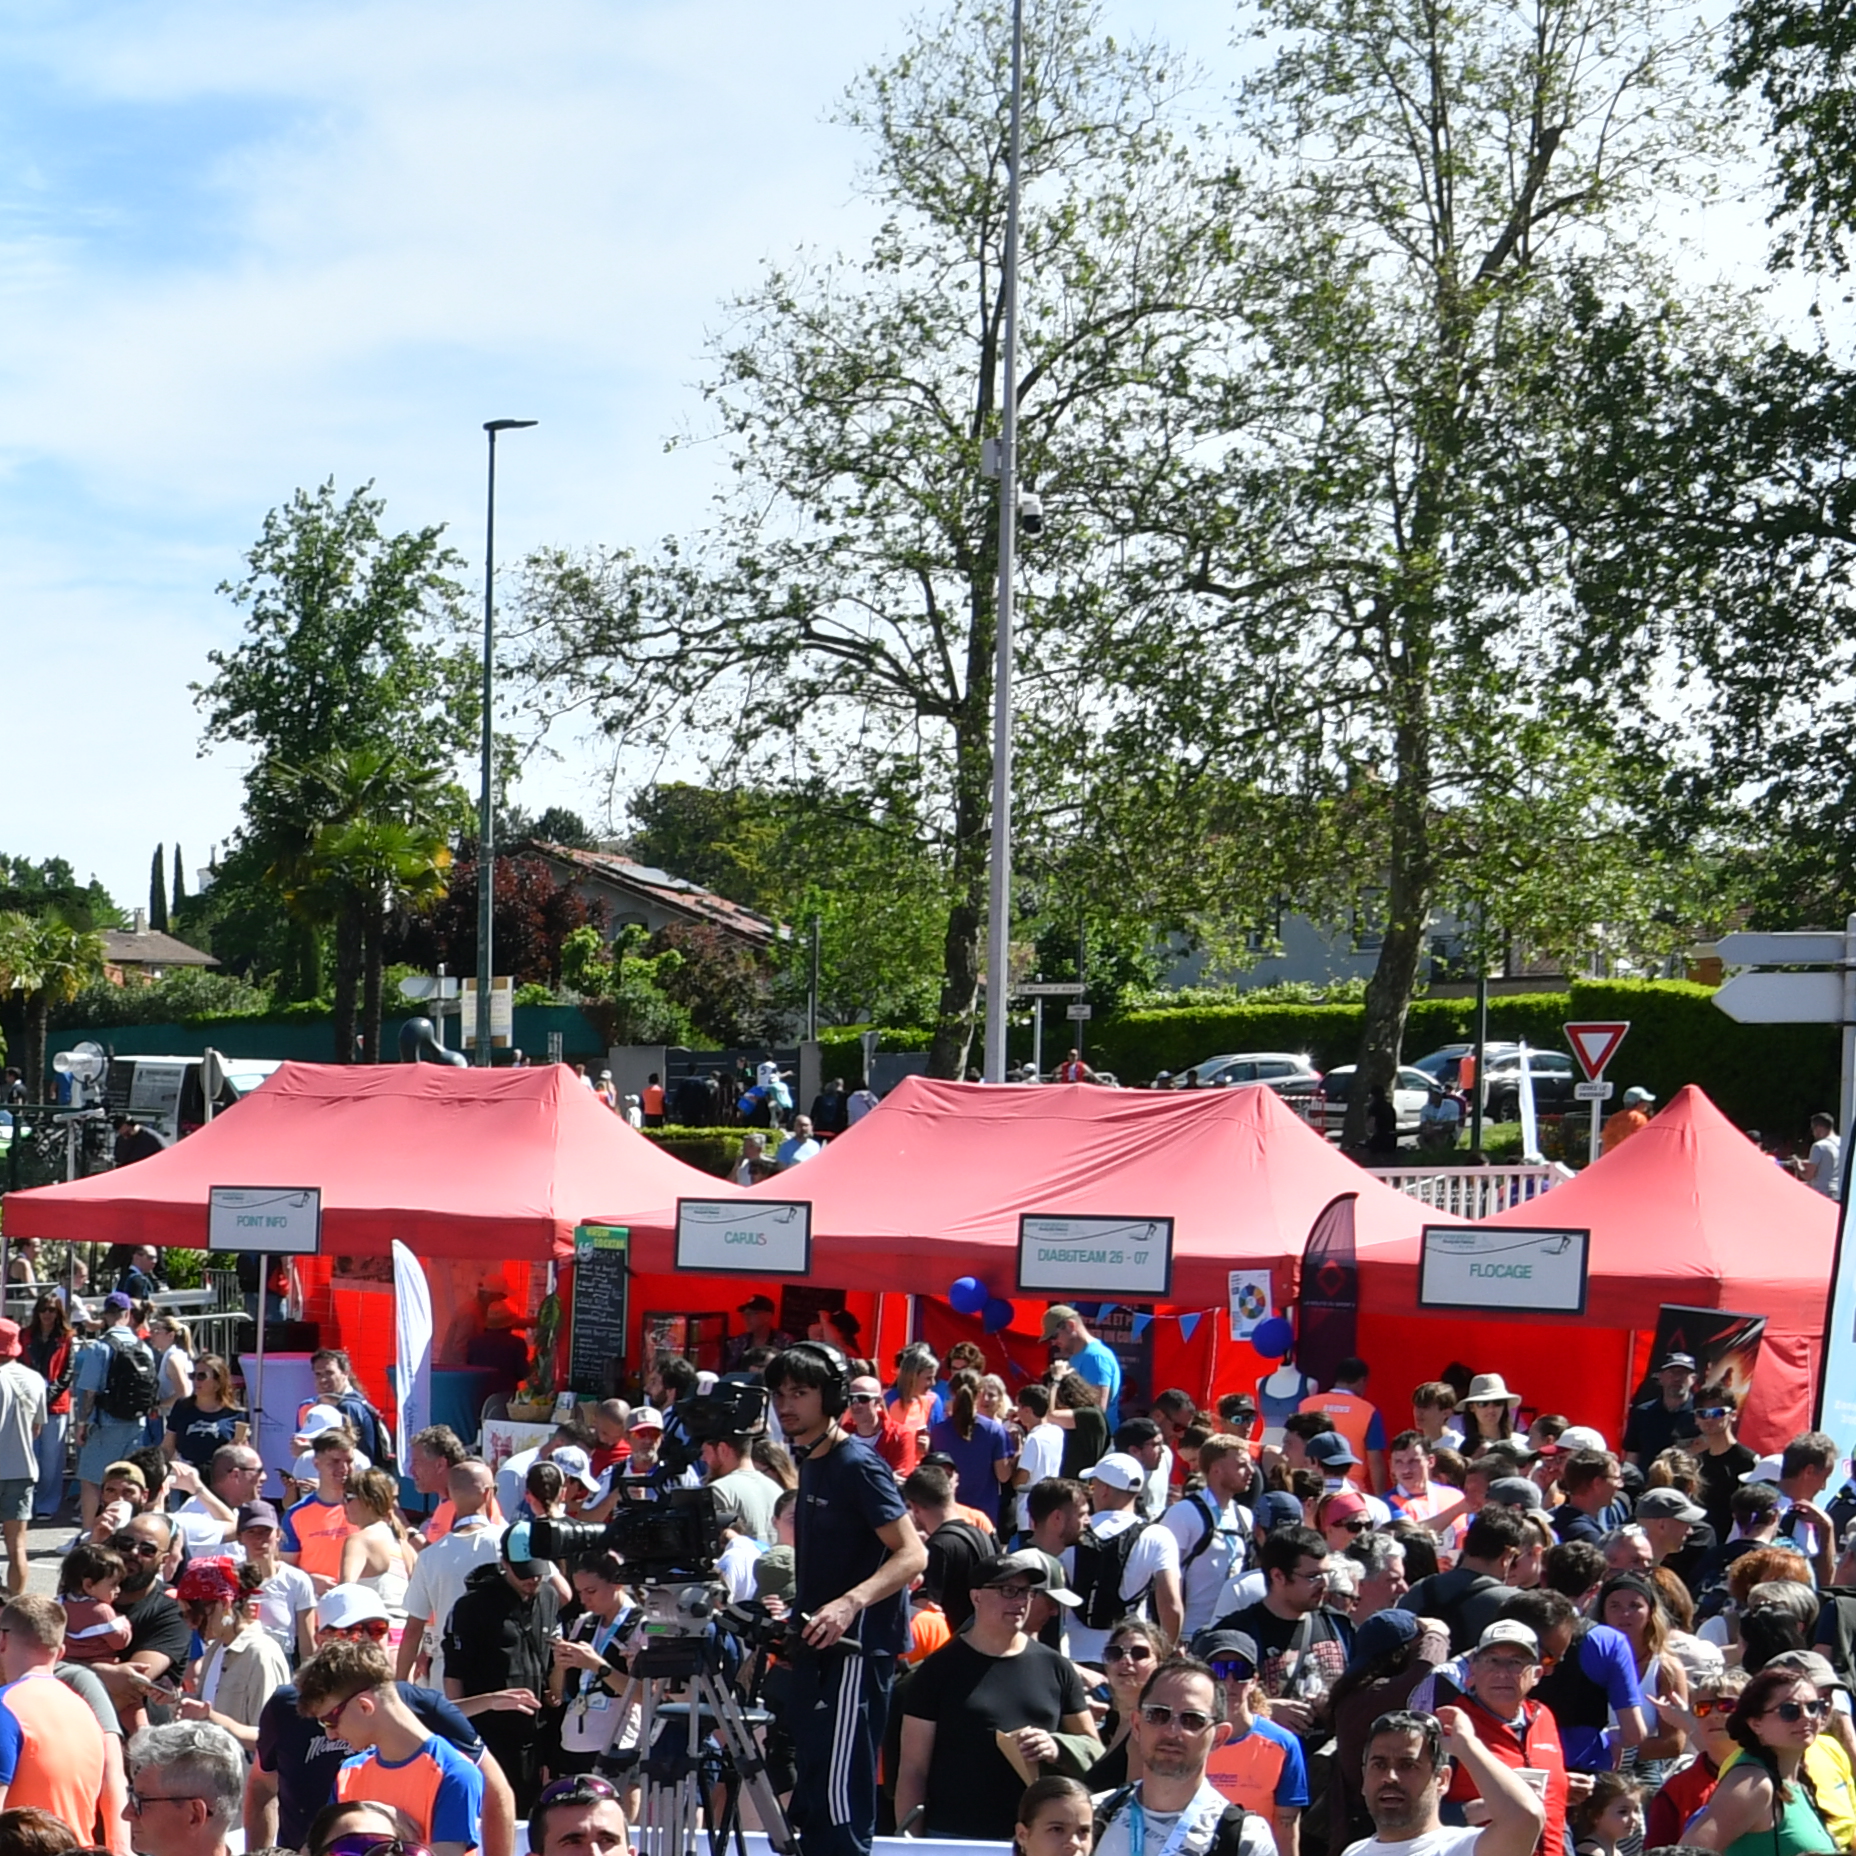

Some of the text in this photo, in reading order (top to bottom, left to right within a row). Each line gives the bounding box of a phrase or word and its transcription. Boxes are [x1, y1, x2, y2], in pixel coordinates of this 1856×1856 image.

[236, 1215, 288, 1228] POINT INFO
[1109, 1250, 1124, 1264] 26
[1134, 1251, 1149, 1265] 07
[1469, 1262, 1533, 1279] FLOCAGE
